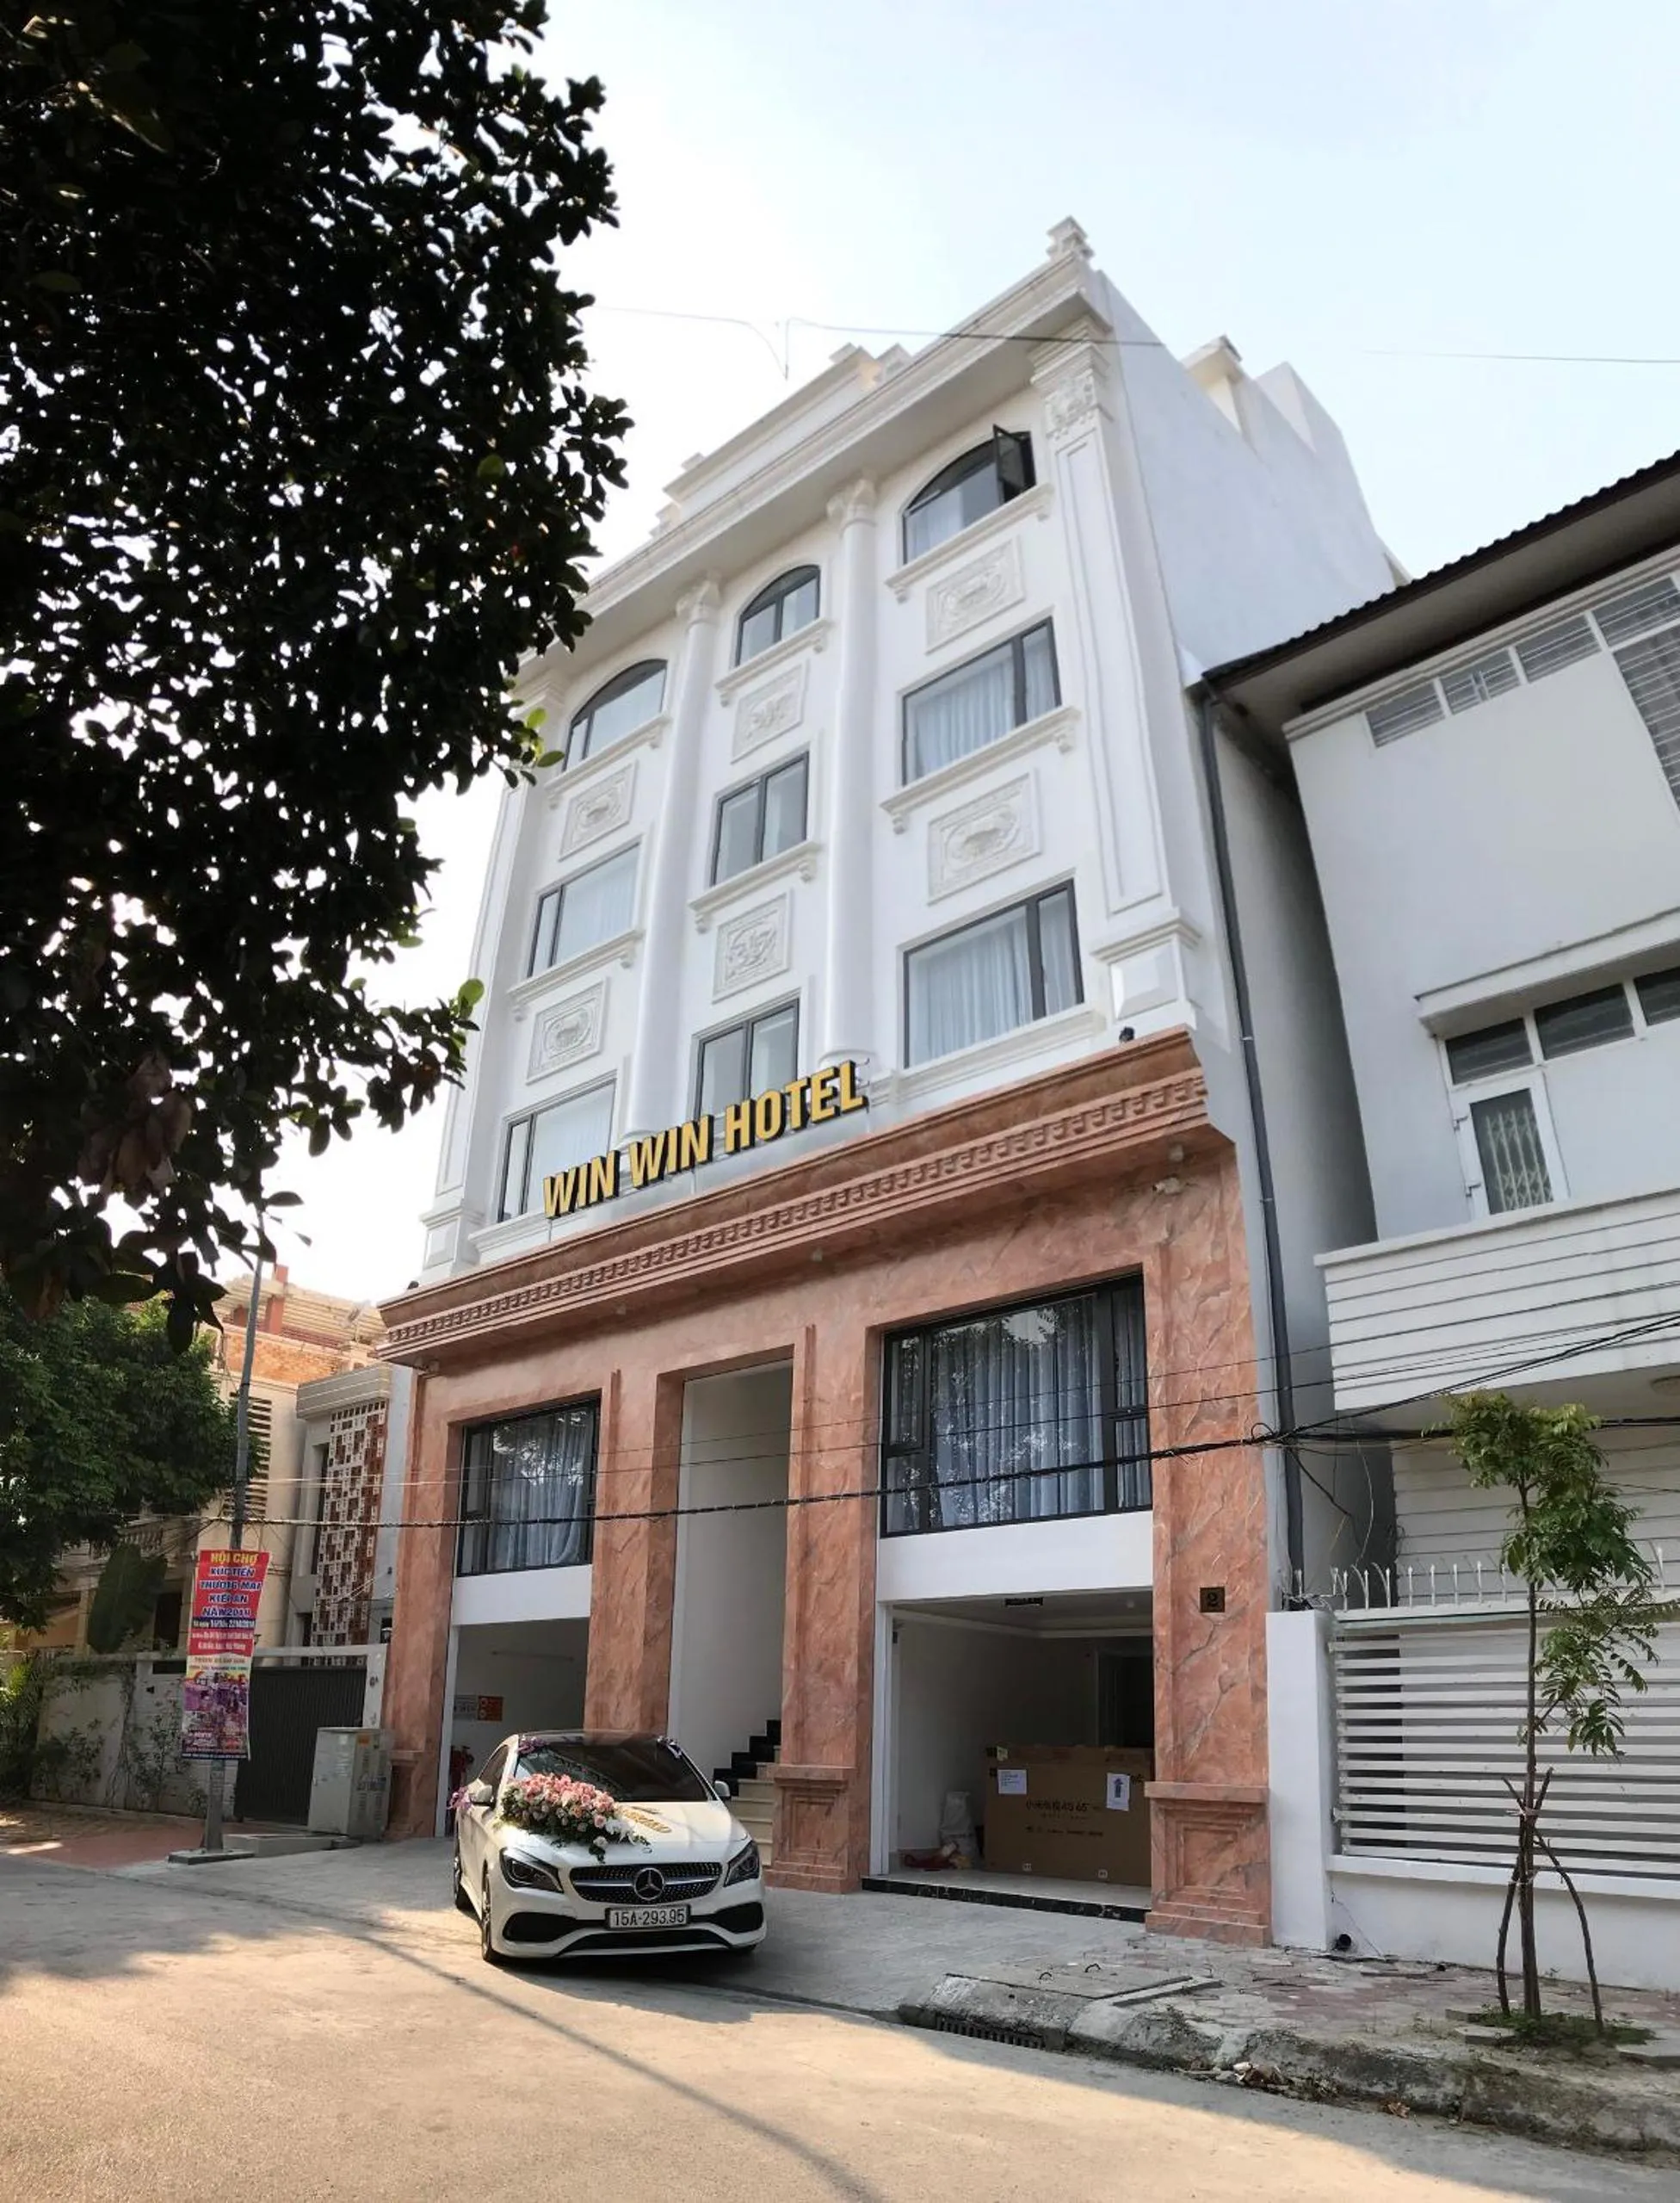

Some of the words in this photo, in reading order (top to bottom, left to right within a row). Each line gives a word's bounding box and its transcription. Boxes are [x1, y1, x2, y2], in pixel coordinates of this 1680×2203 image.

[542, 1149, 621, 1219] WIN
[629, 1114, 714, 1189] WIN
[724, 1060, 868, 1154] HOTEL
[614, 1908, 686, 1927] 15A-293.95
